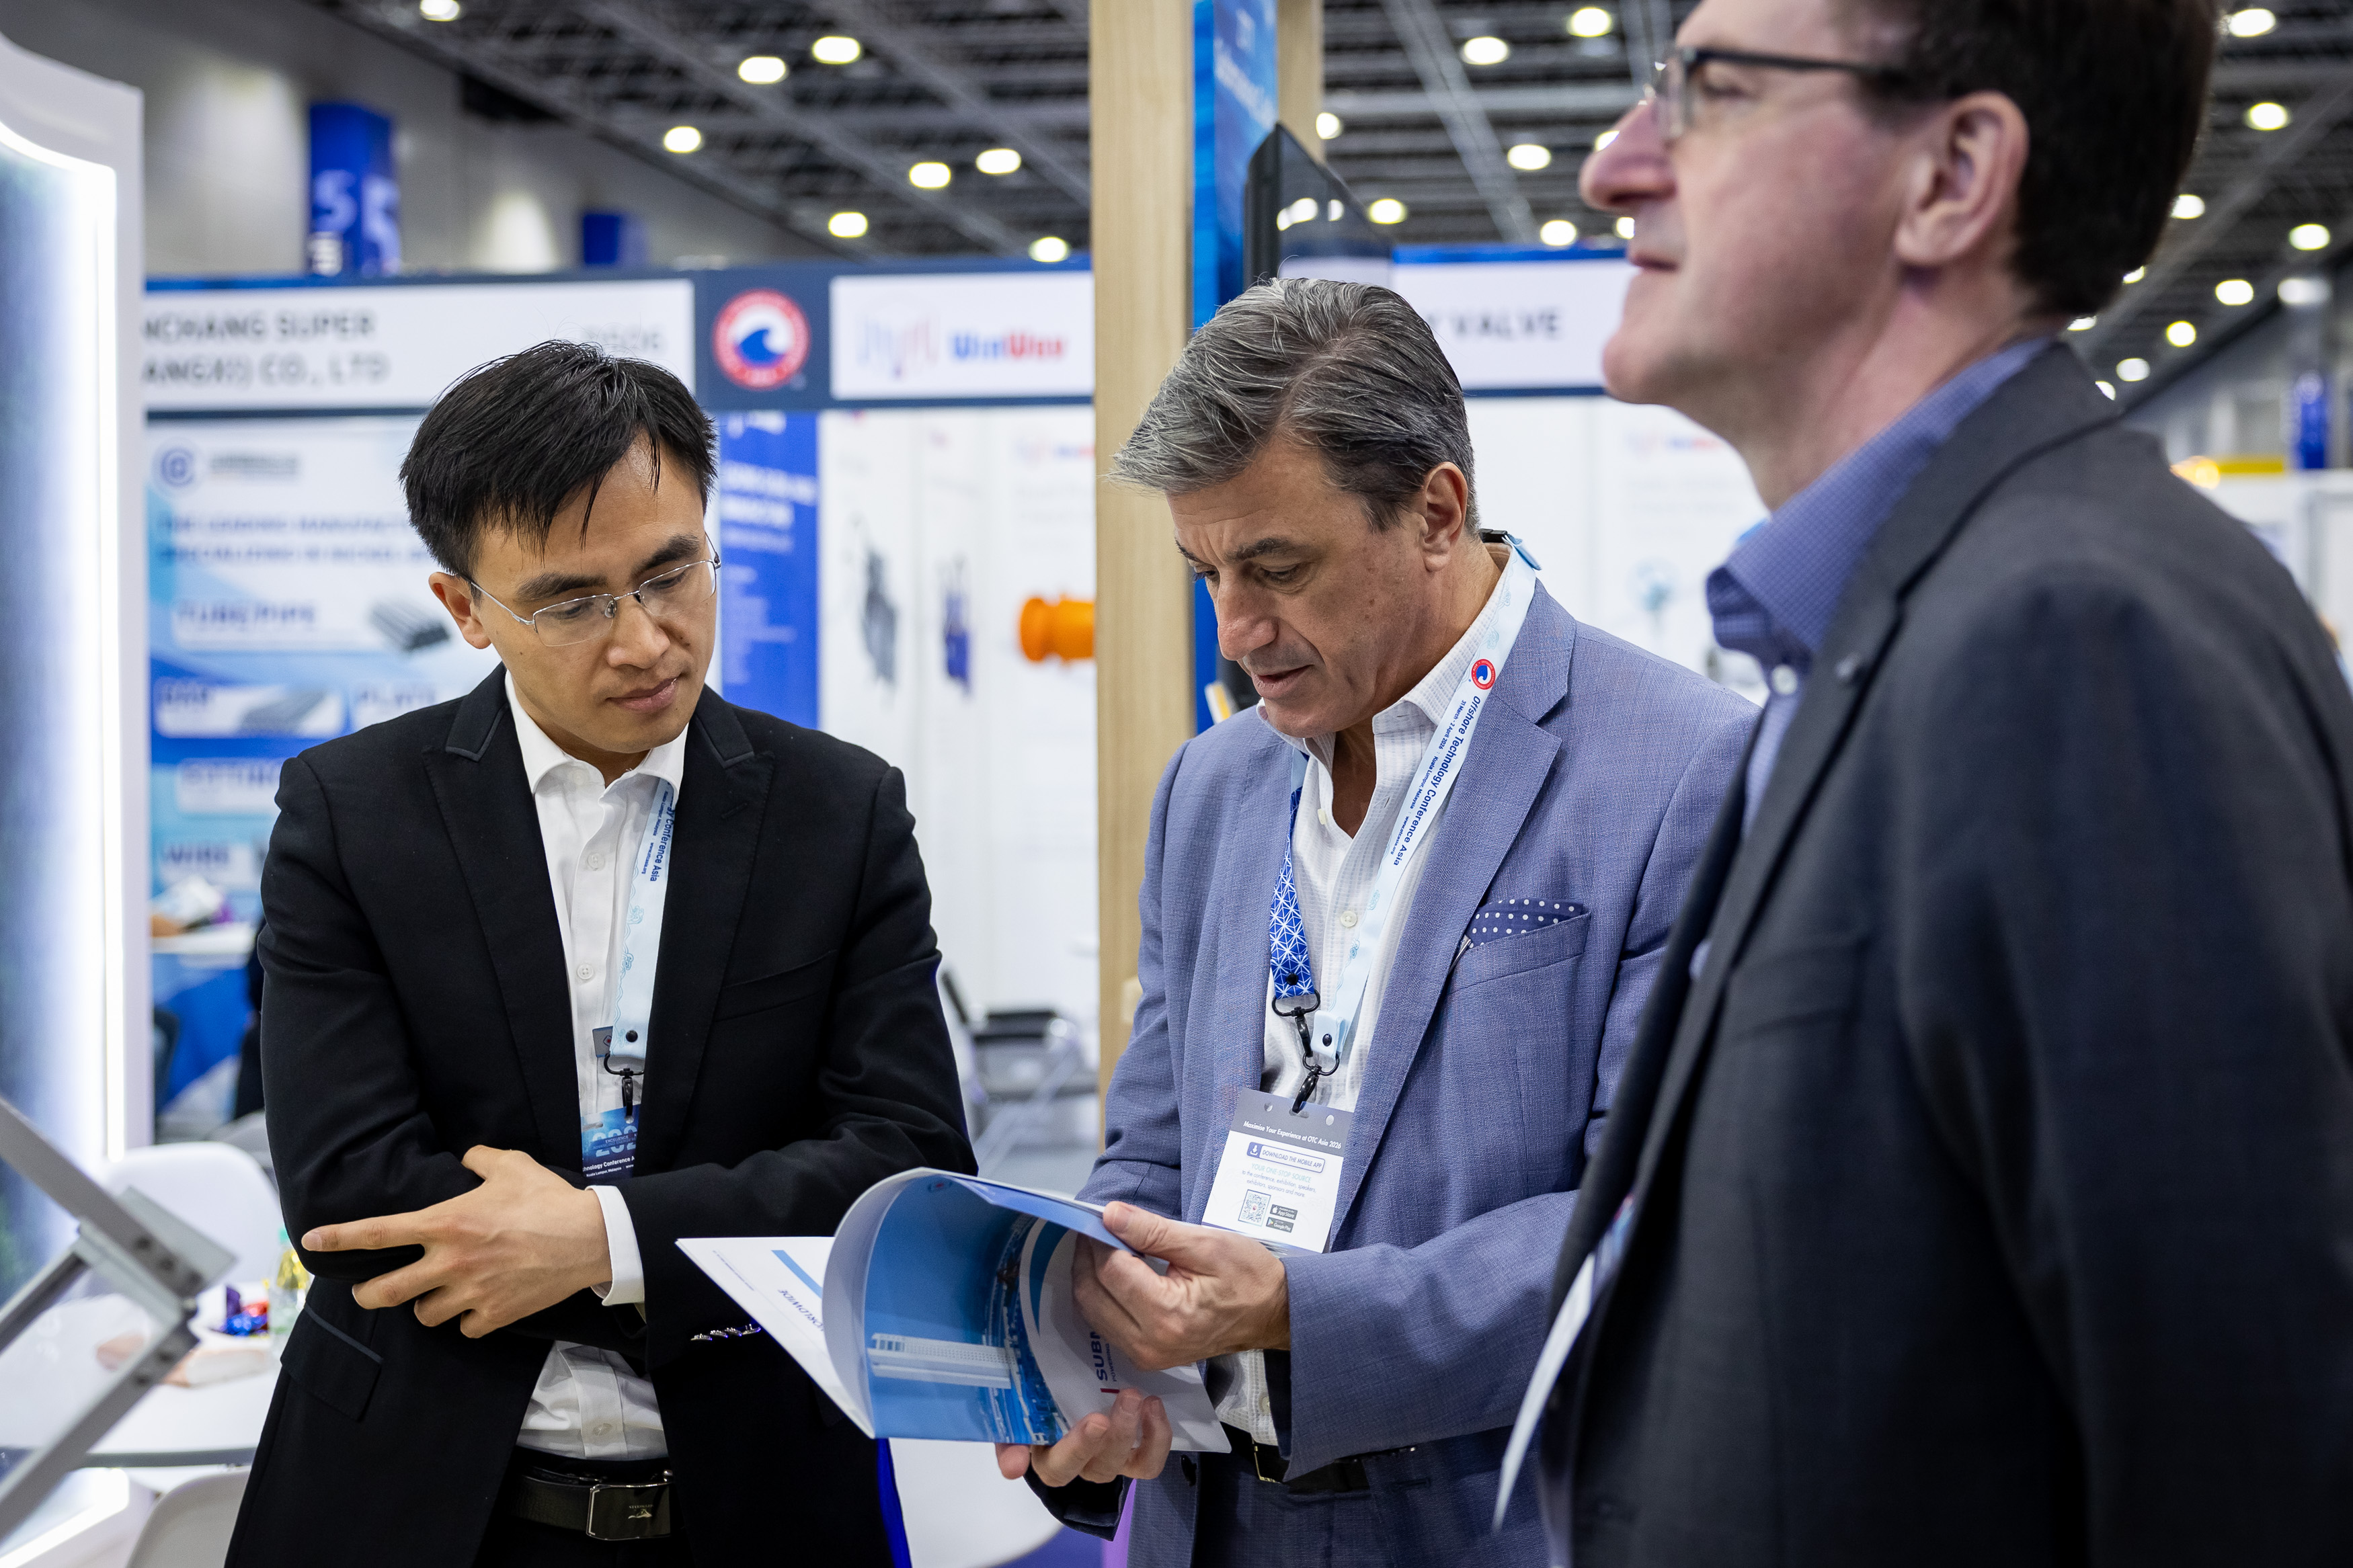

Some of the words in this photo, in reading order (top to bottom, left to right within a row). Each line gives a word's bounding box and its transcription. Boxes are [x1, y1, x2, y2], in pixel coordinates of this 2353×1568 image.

[1450, 309, 1562, 340] VALVE
[1453, 705, 1464, 719] March
[1458, 696, 1480, 734] Offshore
[1444, 726, 1452, 737] April
[1438, 737, 1447, 749] 2026
[1429, 755, 1438, 770] Kuala
[1431, 736, 1464, 788] Technology
[1419, 770, 1432, 787] Lumpur,
[1410, 788, 1423, 809] Malaysia
[1404, 789, 1436, 843] Conference
[653, 818, 662, 835] Malaysia
[655, 818, 675, 863] Conference
[1393, 844, 1406, 865] Asia
[649, 864, 662, 881] Asia
[1242, 1120, 1265, 1131] Maximise
[1266, 1125, 1277, 1133] Your
[1276, 1128, 1301, 1139] Experience
[1307, 1135, 1318, 1143] OTC
[1317, 1138, 1328, 1146] Asia
[1328, 1141, 1341, 1149] 2026
[604, 1157, 631, 1167] Conference
[1262, 1149, 1288, 1160] DOWNLOAD
[1297, 1158, 1312, 1166] MOBILE
[1252, 1163, 1265, 1171] YOUR
[1291, 1173, 1311, 1183] SOURCE
[1105, 1343, 1117, 1382] POWERING
